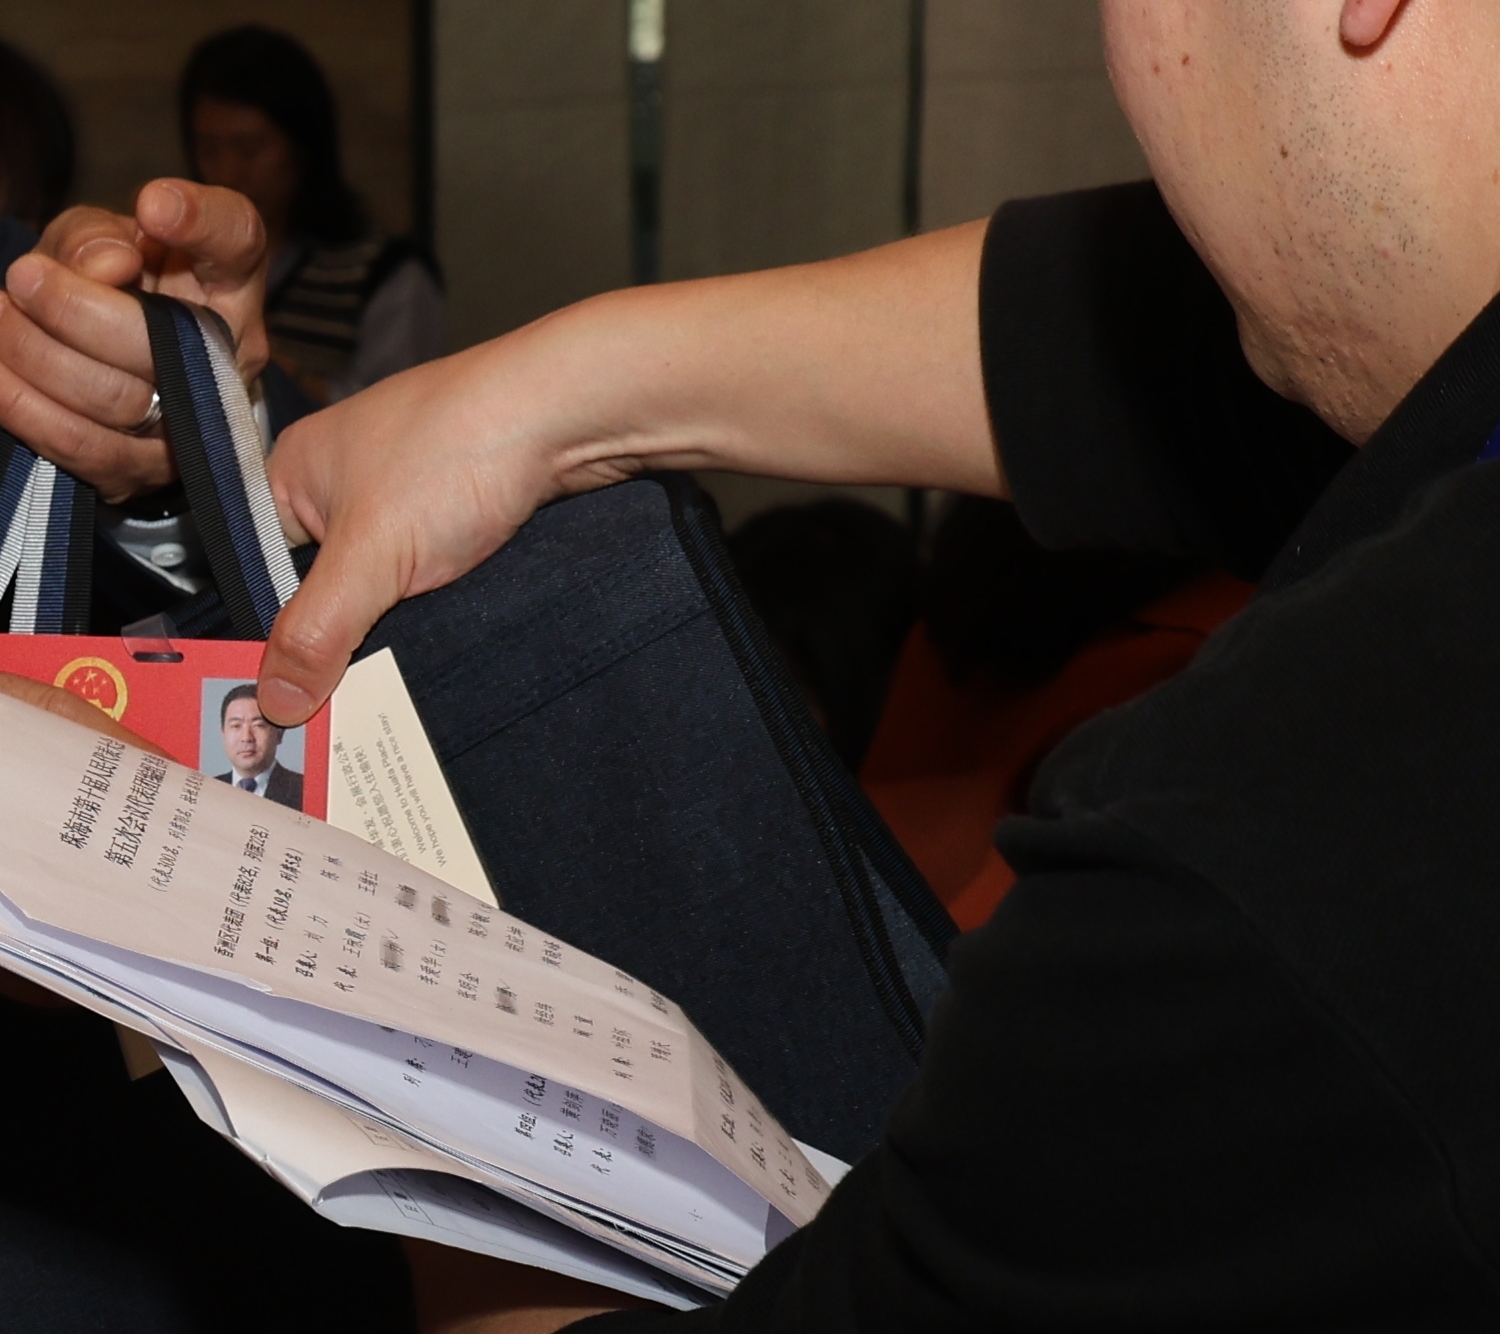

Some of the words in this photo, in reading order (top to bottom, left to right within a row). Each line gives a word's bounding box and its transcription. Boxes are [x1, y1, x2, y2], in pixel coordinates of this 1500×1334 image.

[378, 713, 394, 736] stay!
[376, 737, 389, 768] Place.
[388, 736, 399, 755] nice
[388, 768, 404, 798] Huafa
[400, 764, 416, 790] have
[59, 736, 126, 850] 珠海市第十届人民代表大会
[401, 797, 409, 809] to
[408, 788, 420, 805] will
[417, 805, 430, 823] you
[407, 809, 426, 854] Welcome
[424, 823, 441, 850] hope
[435, 851, 447, 867] We
